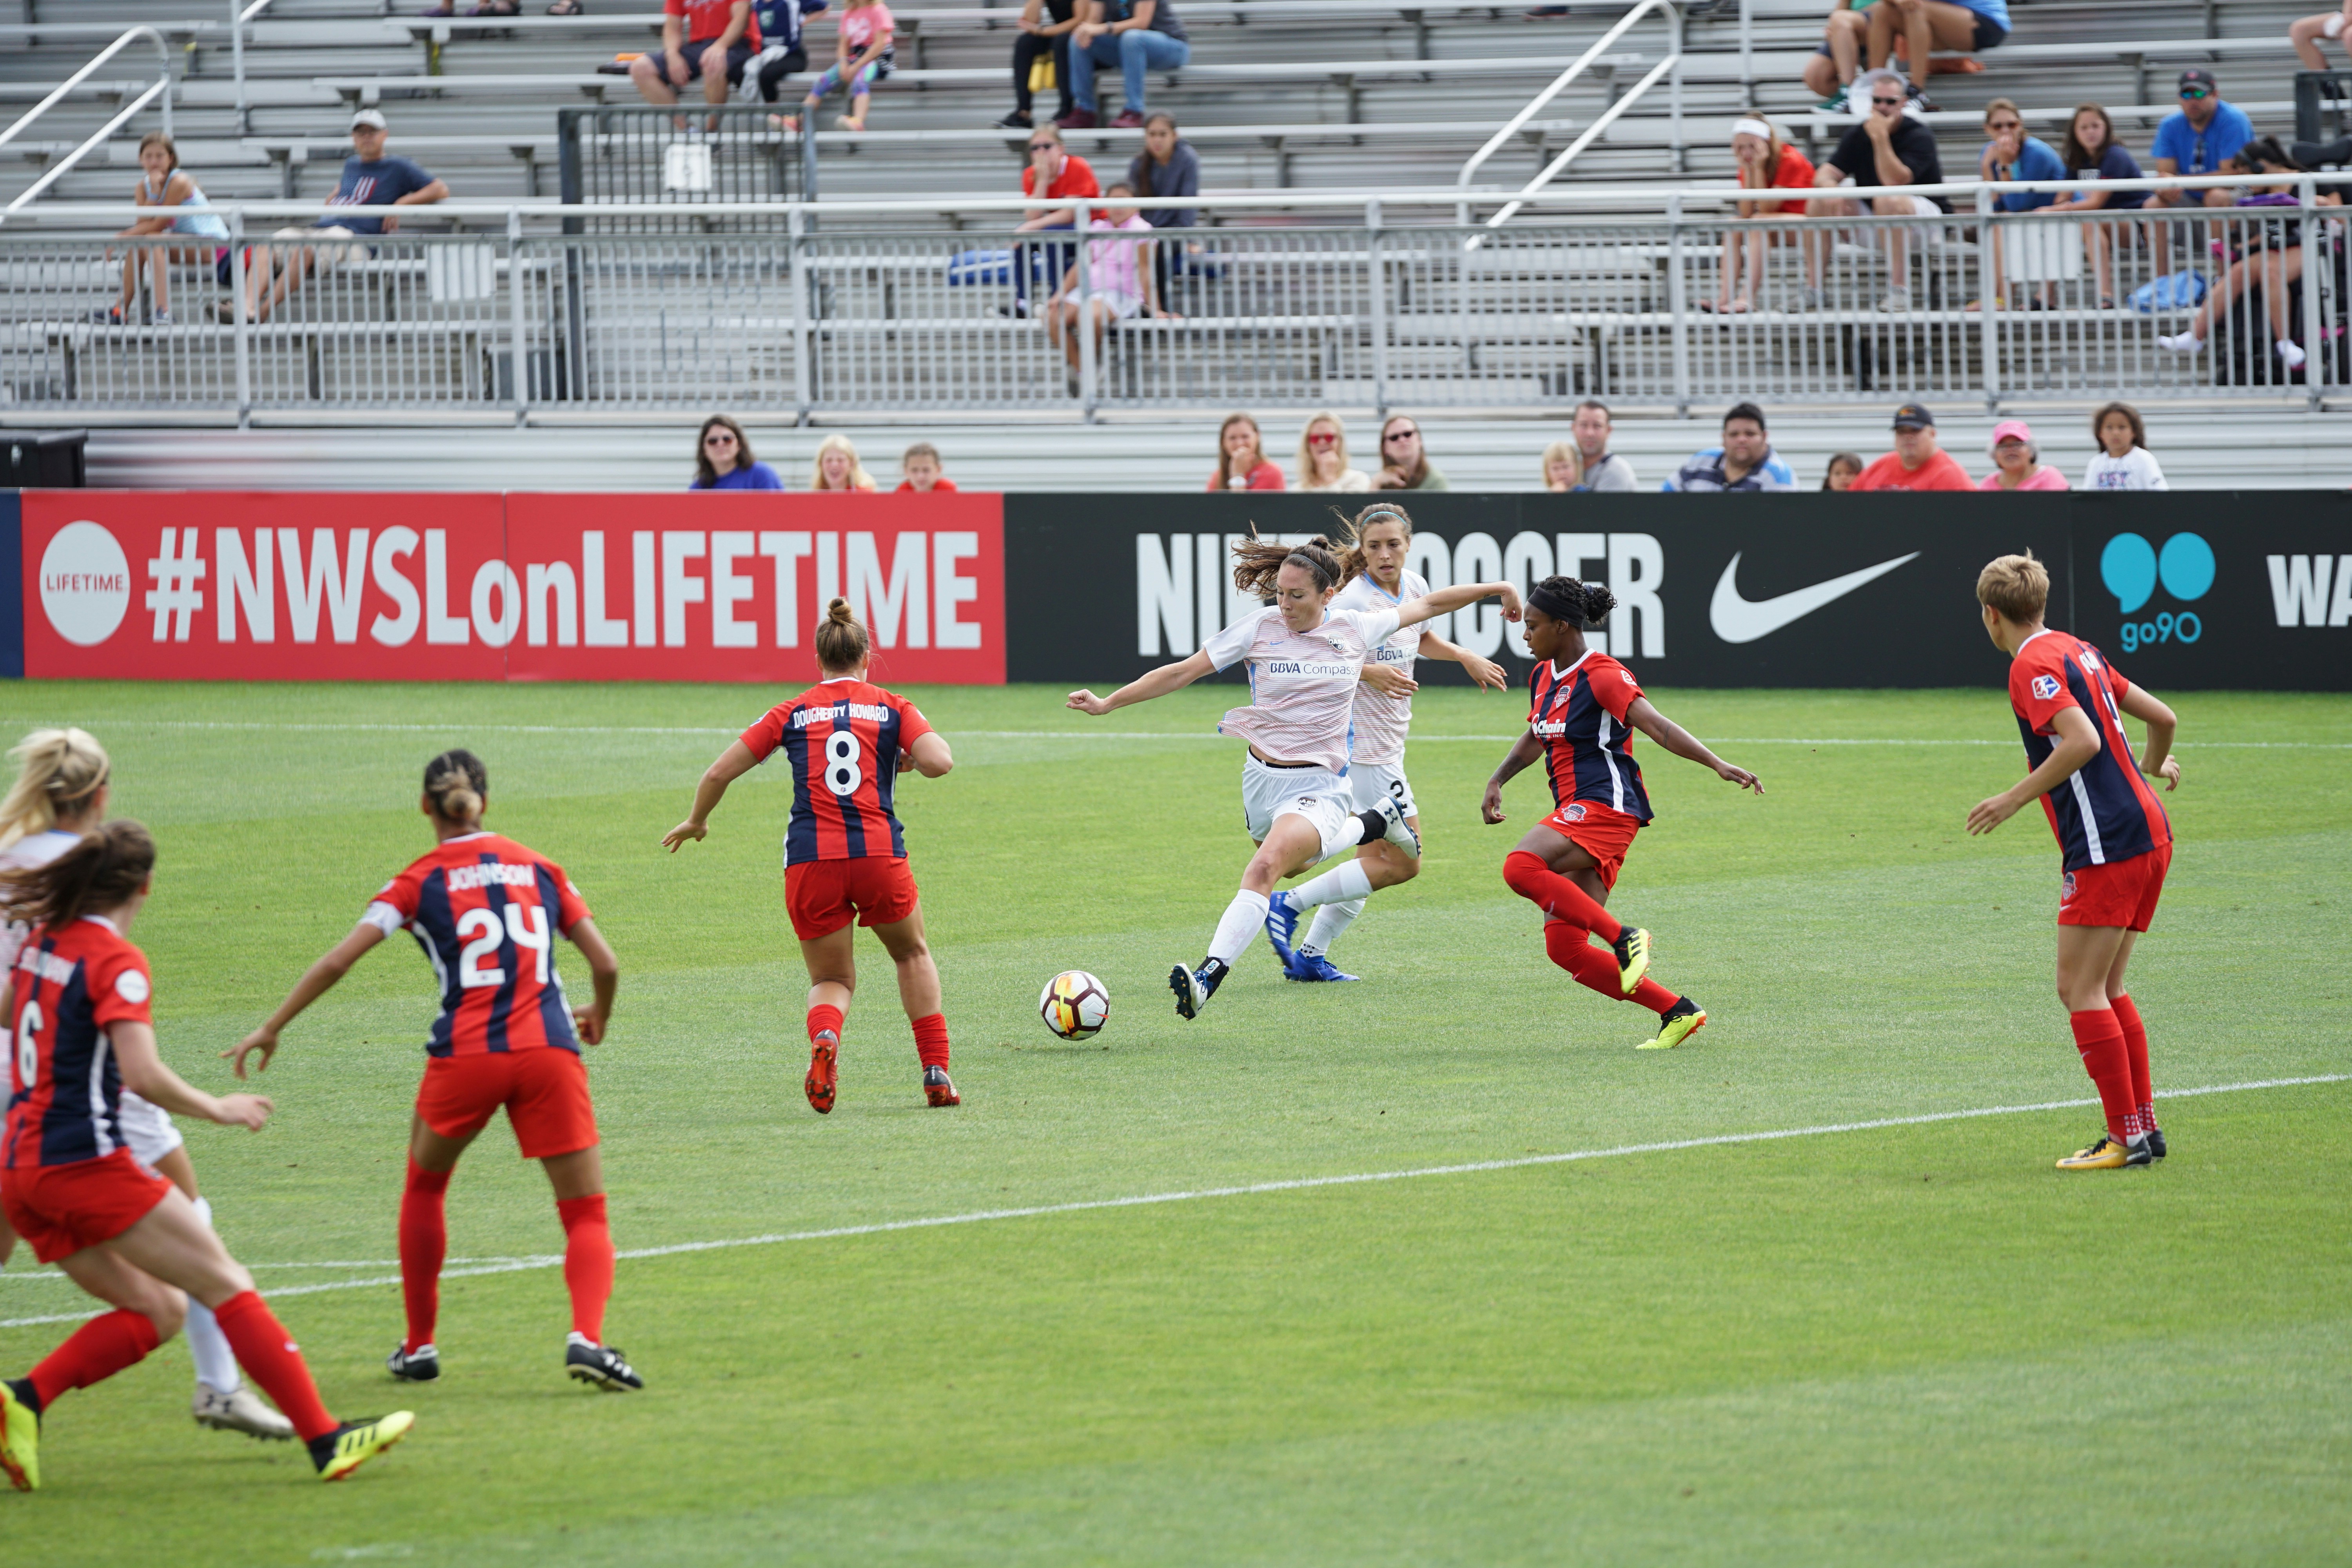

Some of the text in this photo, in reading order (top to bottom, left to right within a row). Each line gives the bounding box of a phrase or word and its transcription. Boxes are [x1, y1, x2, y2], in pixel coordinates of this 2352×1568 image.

[46, 573, 123, 592] LIFETIME
[145, 525, 981, 648] #NWSLonLIFETIME
[2120, 611, 2202, 653] go90
[1270, 663, 1355, 676] BBVA Compass
[1377, 650, 1403, 661] BBVA
[793, 703, 889, 728] DOUGHERTY HOWARD
[825, 730, 862, 796] 8
[447, 862, 535, 892] JOHNSON
[456, 902, 550, 988] 24
[18, 1000, 44, 1087] 6
